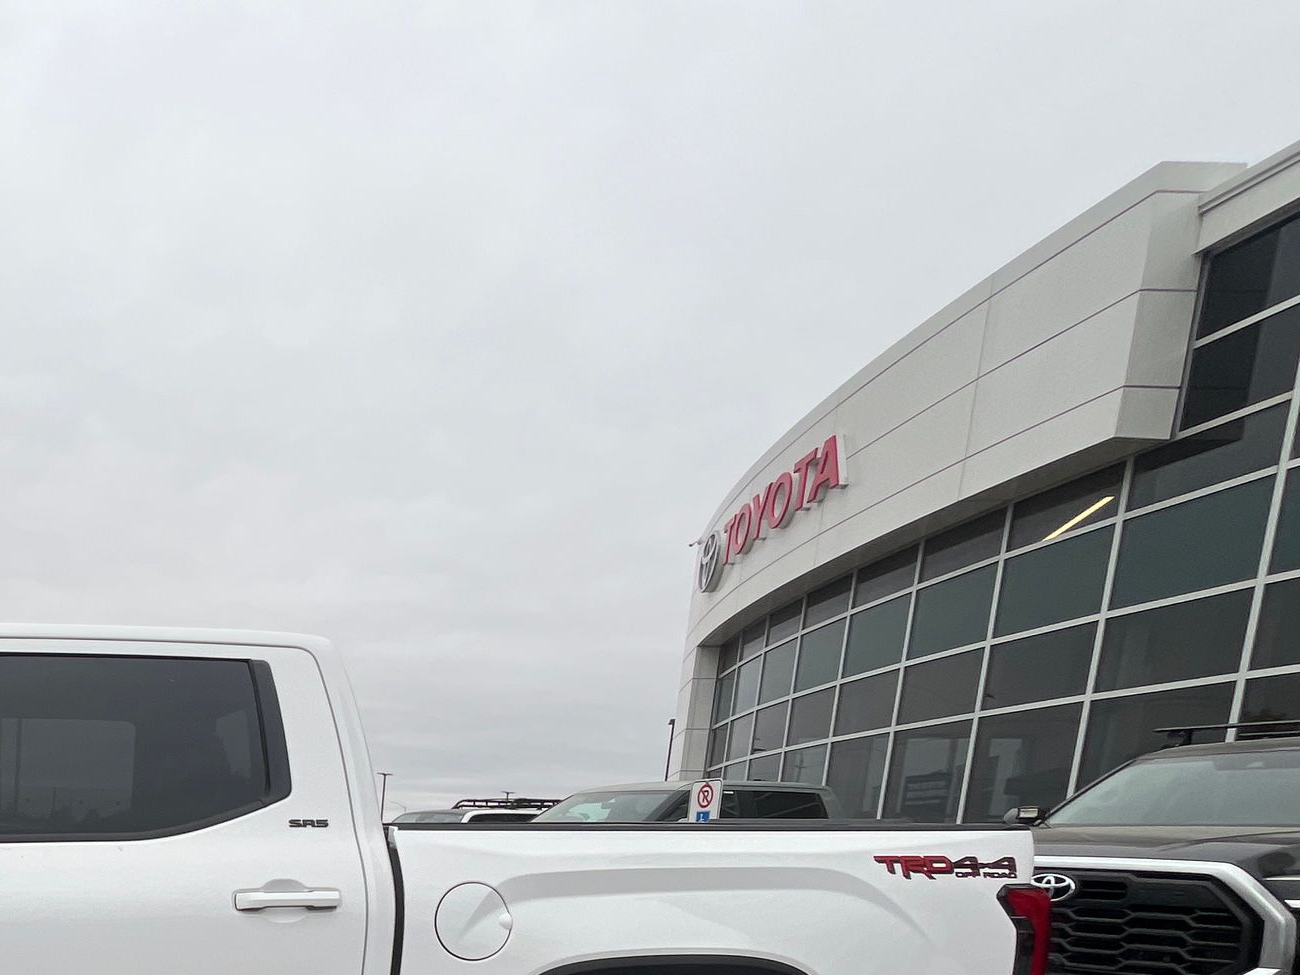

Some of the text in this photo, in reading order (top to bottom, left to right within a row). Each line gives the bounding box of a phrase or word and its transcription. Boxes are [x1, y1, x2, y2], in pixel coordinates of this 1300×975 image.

[723, 434, 844, 566] TOYOTA
[288, 819, 329, 828] SR5
[873, 855, 954, 880] TRD
